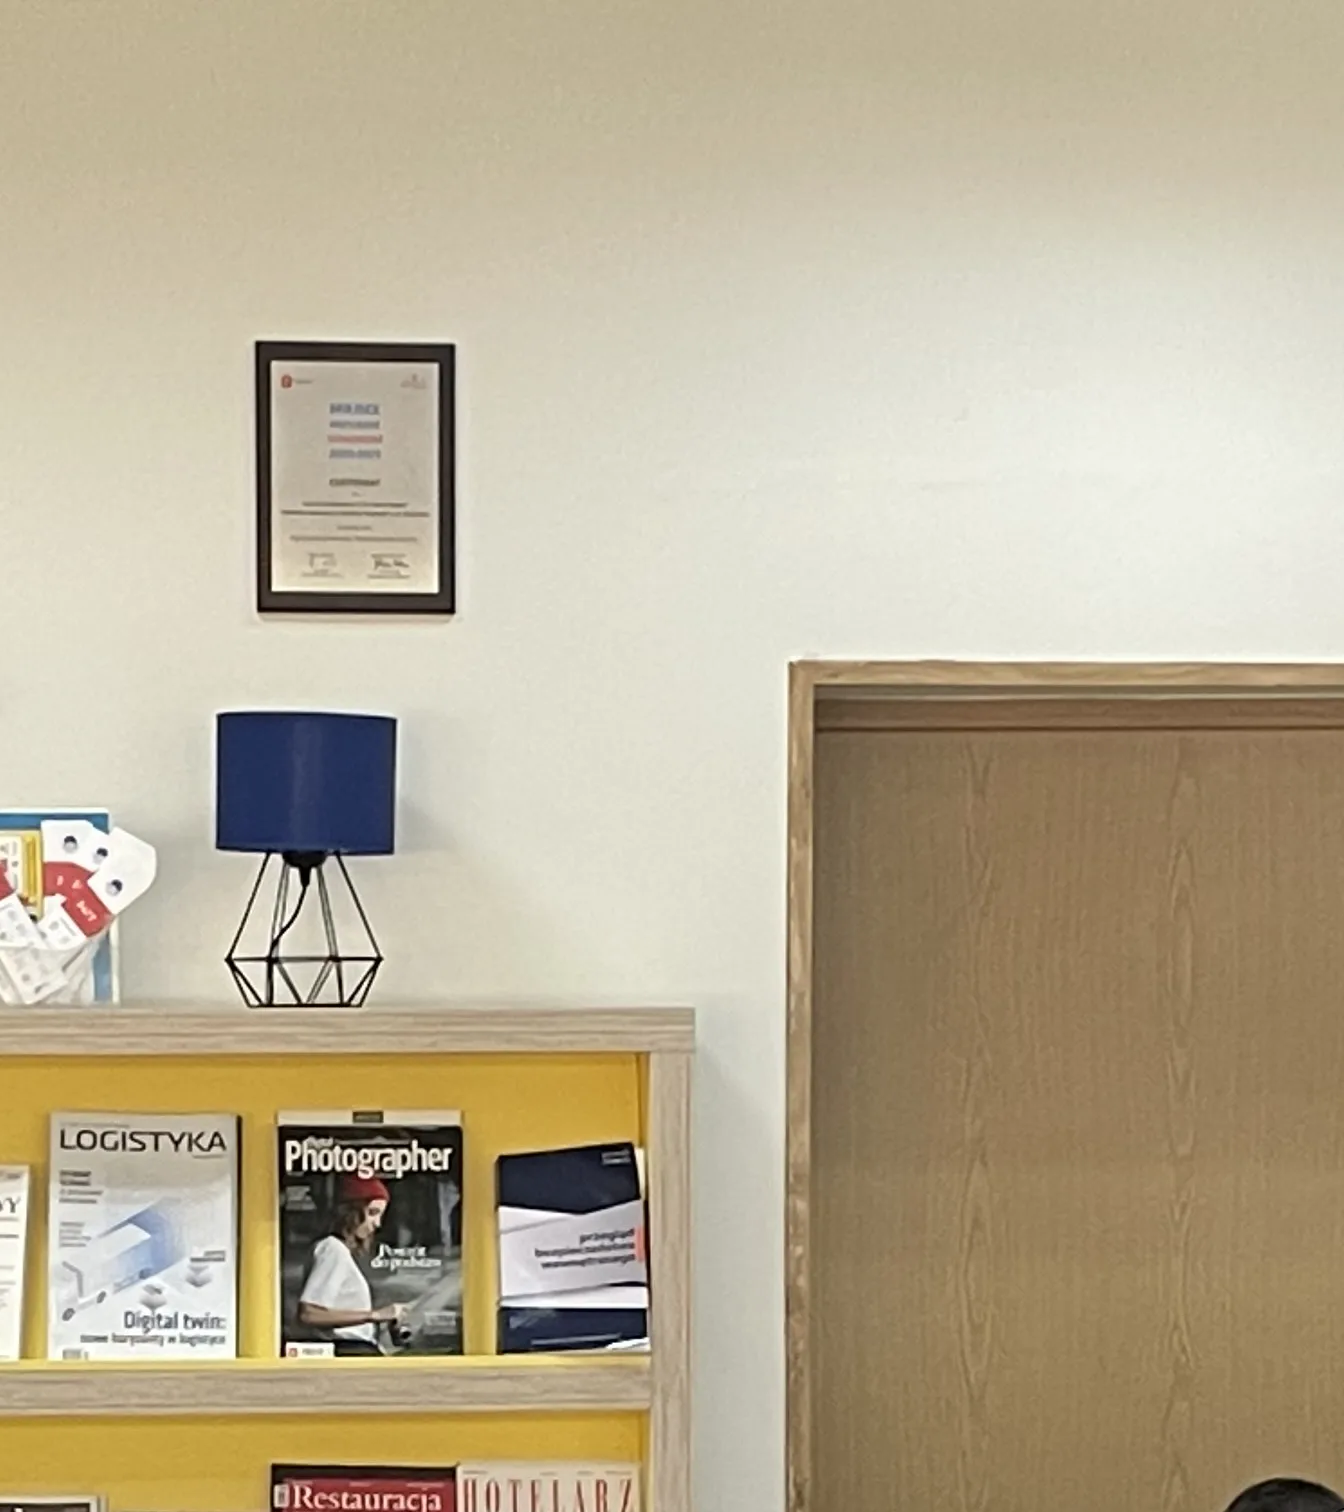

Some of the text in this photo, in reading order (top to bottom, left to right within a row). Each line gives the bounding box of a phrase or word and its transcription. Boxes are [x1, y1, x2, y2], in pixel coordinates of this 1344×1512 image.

[60, 1129, 227, 1152] LOGISTYKA
[285, 1140, 453, 1179] Photographer
[123, 1311, 226, 1334] Digital twin:
